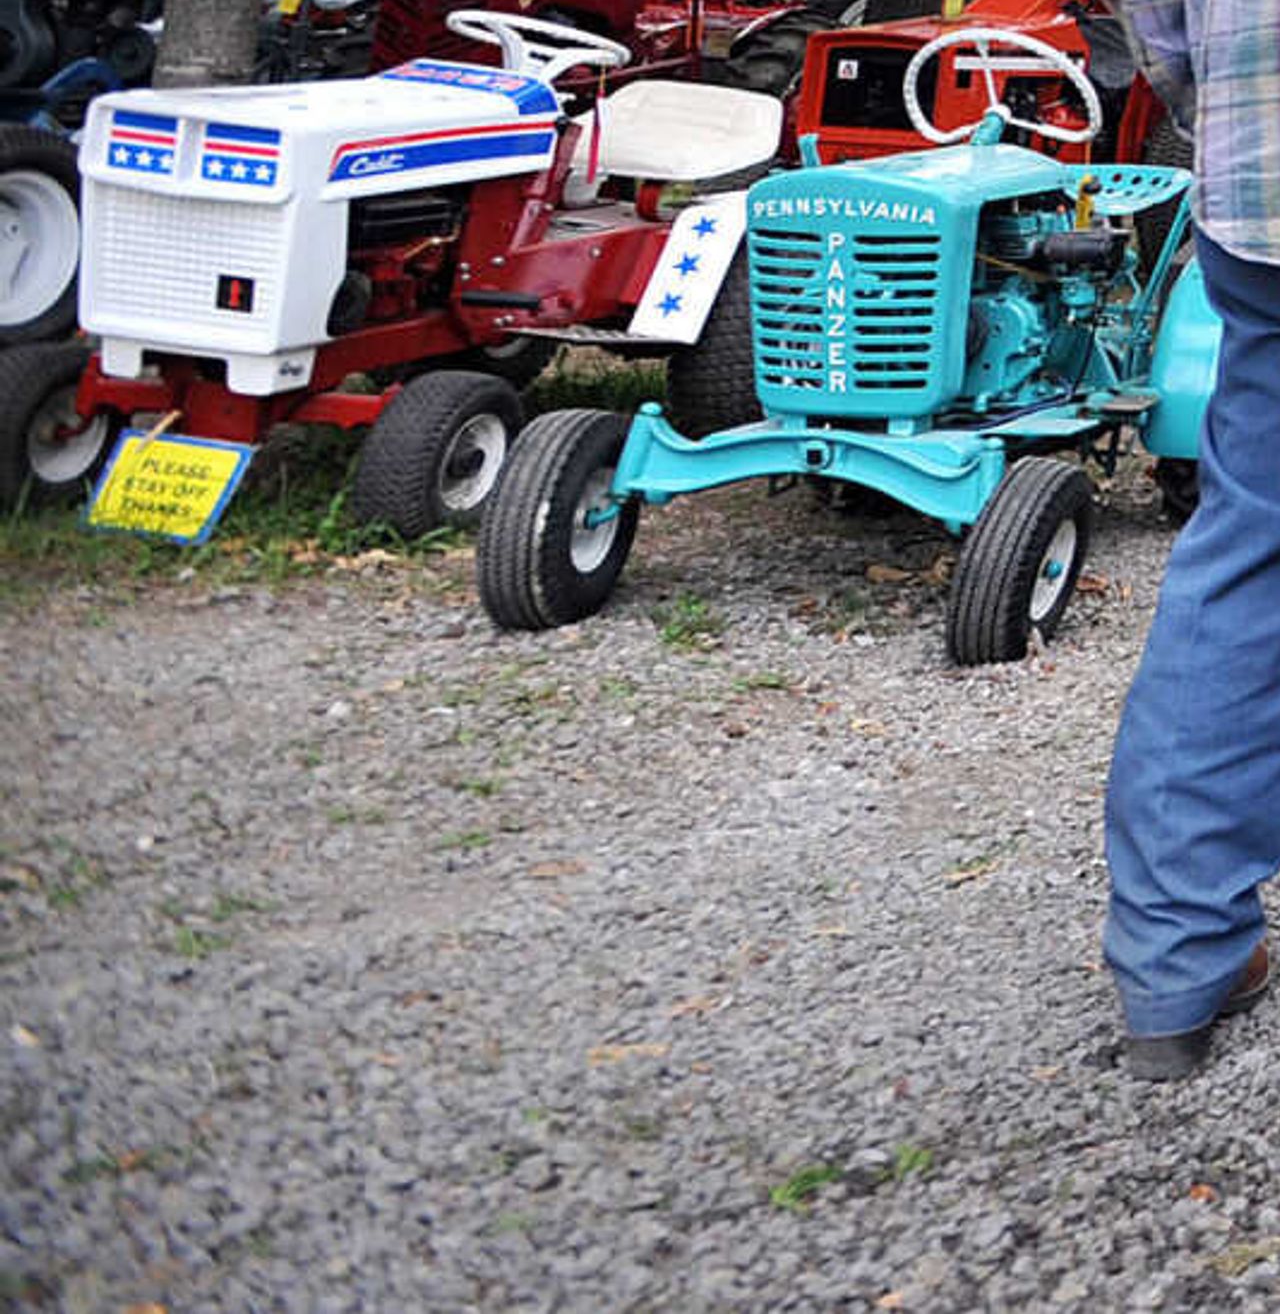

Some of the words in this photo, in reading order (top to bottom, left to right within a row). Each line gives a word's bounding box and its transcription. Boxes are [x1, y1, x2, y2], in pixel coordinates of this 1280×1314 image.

[753, 196, 936, 224] PENNSYLVANIA
[827, 232, 847, 393] PANZER
[142, 458, 213, 479] PLEASE
